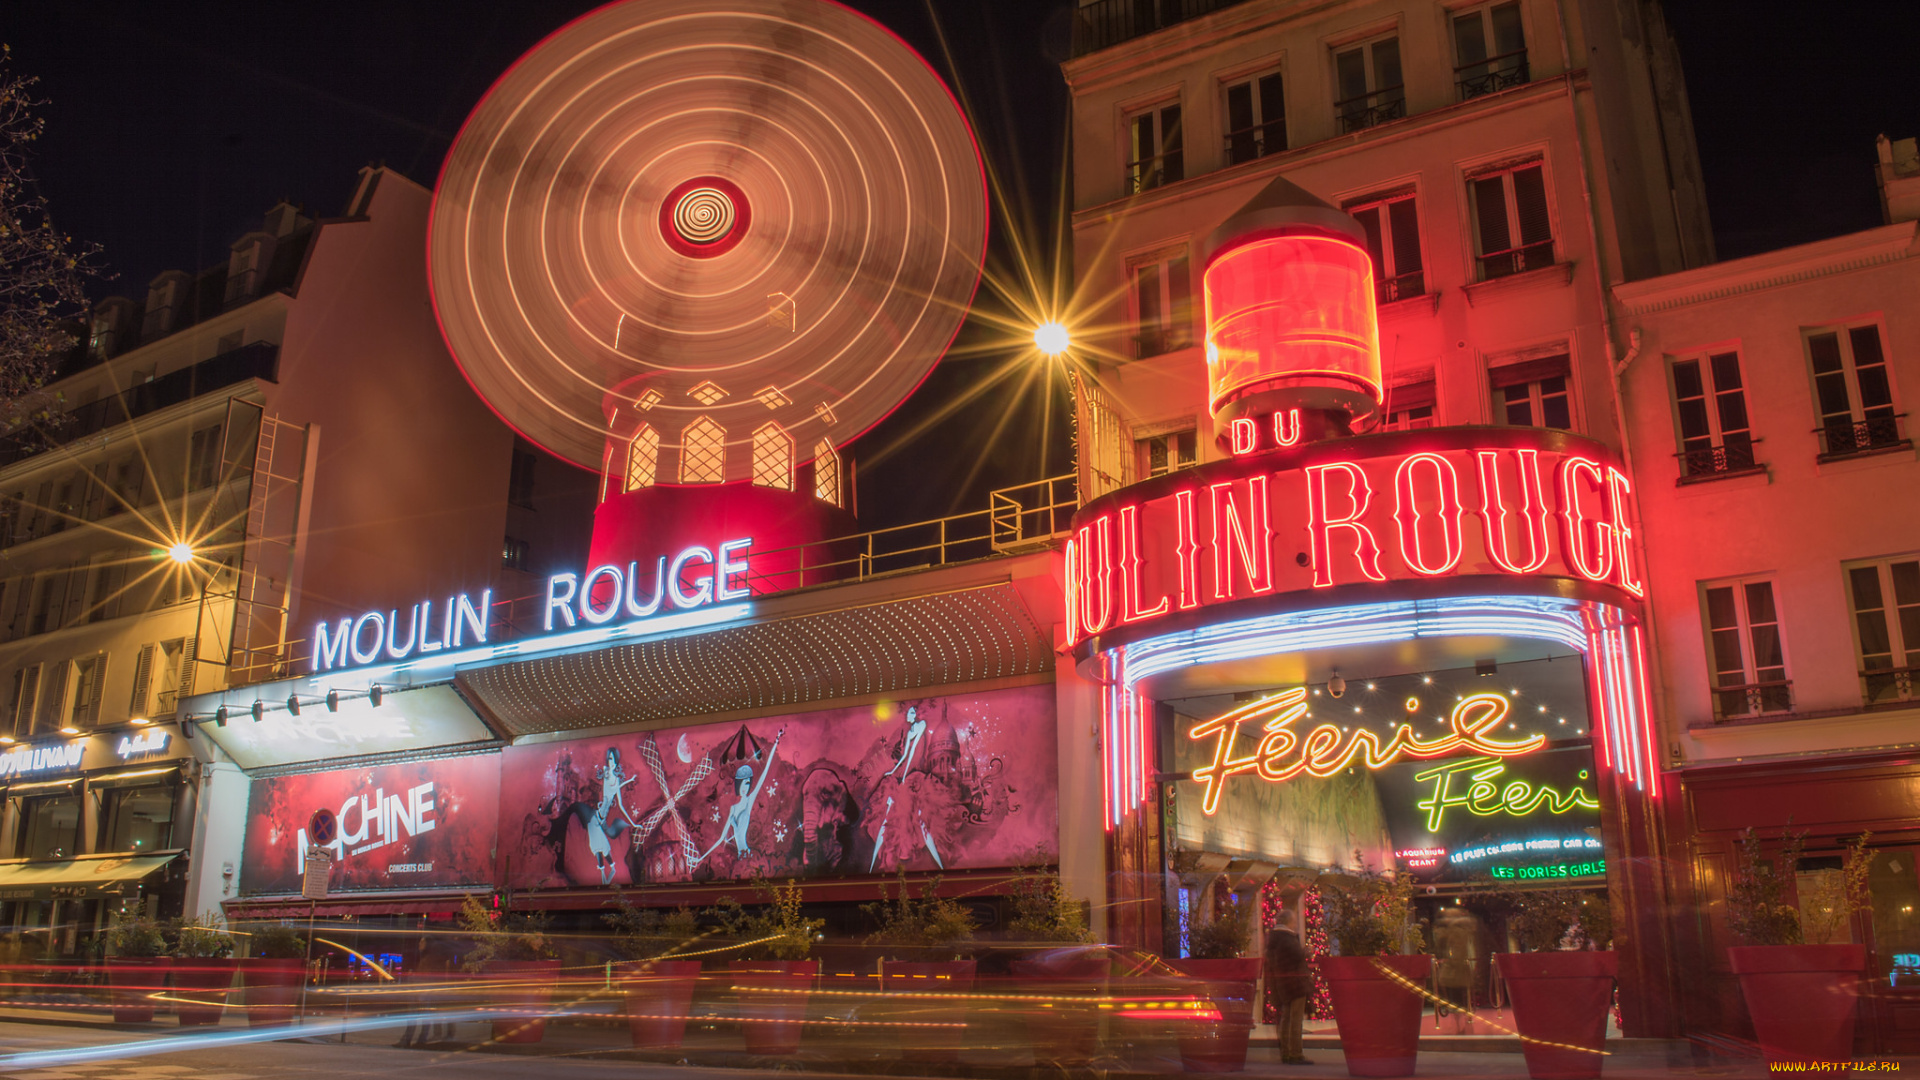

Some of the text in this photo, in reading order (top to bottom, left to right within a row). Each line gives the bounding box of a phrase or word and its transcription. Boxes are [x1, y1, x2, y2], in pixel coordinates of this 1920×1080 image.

[1231, 409, 1301, 455] DU
[1304, 448, 1644, 598] ROUGE
[311, 536, 754, 671] MOULIN ROUGE
[1189, 686, 1546, 815] Féerie
[388, 862, 433, 873] CONCERTS CLUB
[1463, 848, 1486, 861] PLUS
[1491, 860, 1606, 879] LES DORISS GIRLS
